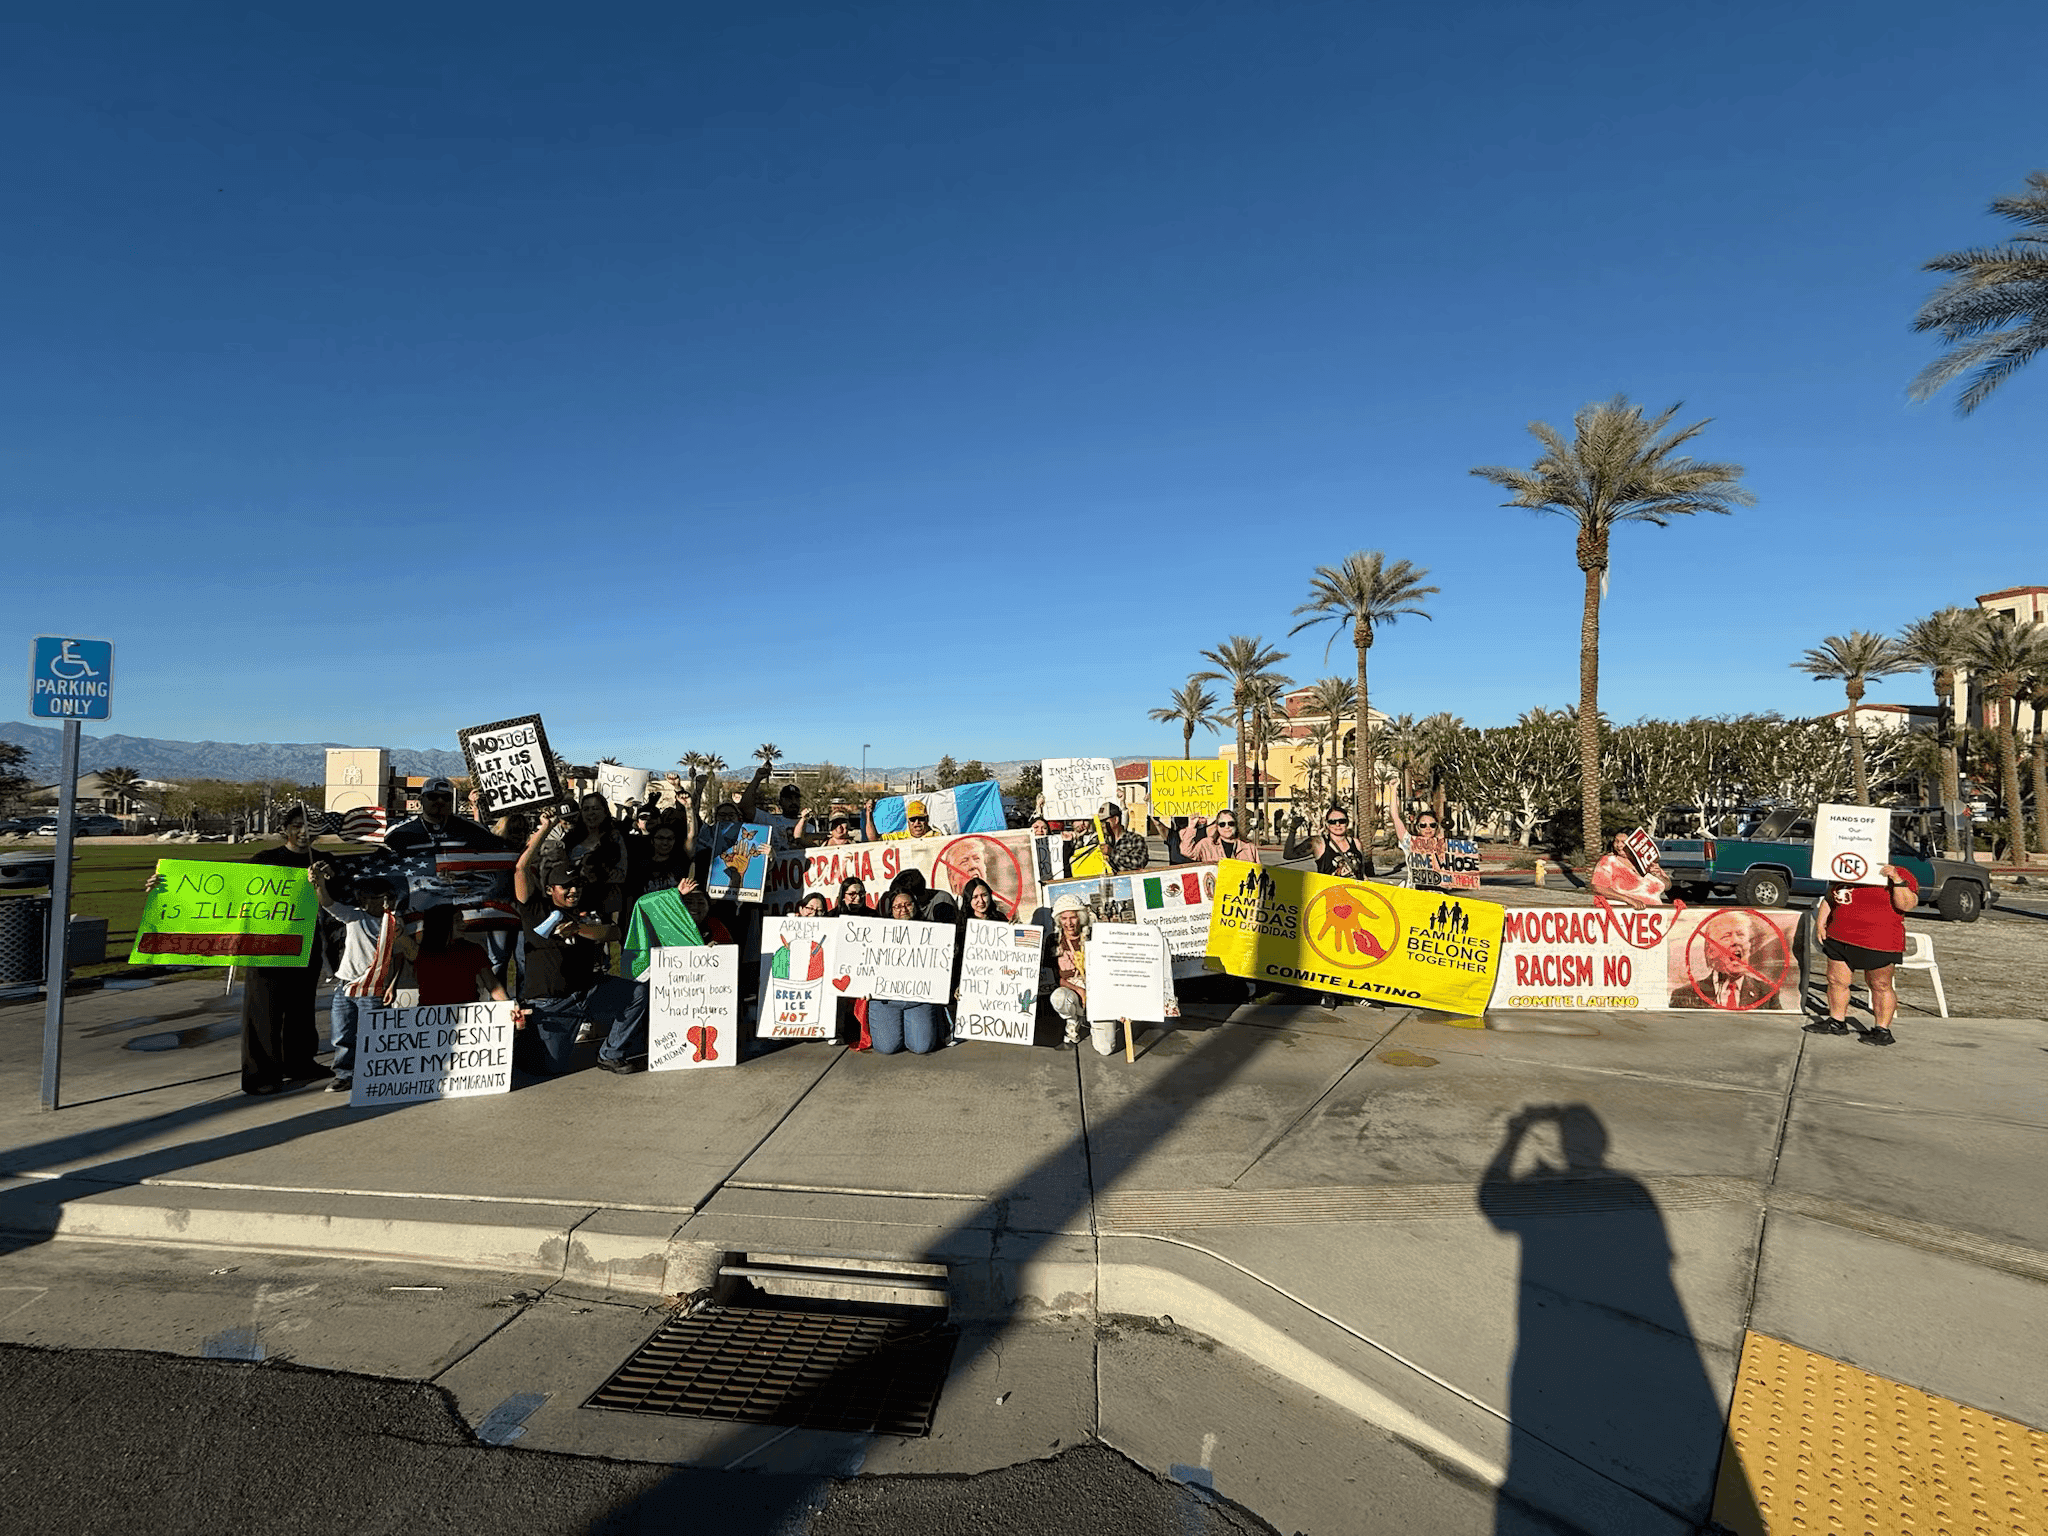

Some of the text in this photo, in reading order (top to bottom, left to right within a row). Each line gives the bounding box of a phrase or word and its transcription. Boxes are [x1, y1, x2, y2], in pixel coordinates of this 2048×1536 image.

[36, 678, 108, 697] PARKING
[50, 697, 92, 715] ONLY
[477, 749, 531, 774] LET US
[481, 768, 518, 789] WORK
[600, 762, 631, 787] FUCK
[1152, 765, 1224, 783] HONK IF
[485, 776, 552, 808] PEACE
[1057, 787, 1081, 800] ESTE
[1155, 784, 1214, 797] YOU HATE
[1829, 815, 1859, 823] HANDS
[881, 847, 901, 880] SI
[1434, 852, 1480, 873] WHOSE
[1839, 858, 1861, 875] ICE
[175, 873, 297, 897] NO ONE
[190, 901, 306, 922] ILLEGAL
[1222, 893, 1299, 915] FAMILIAS
[779, 920, 820, 932] ABOLISH
[1221, 903, 1297, 929] UNIDAS
[845, 921, 873, 944] SER
[919, 926, 936, 946] DE
[969, 922, 1009, 948] YOUR
[1220, 917, 1297, 940] NO DIVIDIDAS
[1409, 926, 1491, 949] FAMILIES
[1503, 911, 1663, 945] MOCRACY YES
[658, 950, 720, 969] This looks
[1406, 937, 1489, 963] BELONG
[839, 963, 876, 977] ES UNA
[1406, 950, 1487, 974] TOGETHER
[1514, 954, 1632, 988] RACISM NO
[874, 976, 932, 996] BENDICION
[962, 978, 1022, 996] THEY JUST
[1265, 964, 1422, 999] COMITE LATINO
[654, 984, 733, 1013] My history books
[775, 989, 813, 1001] BREAK
[784, 1001, 806, 1011] ICE
[1508, 995, 1639, 1009] COMITE LATINO
[366, 1003, 497, 1031] THE COUNTRY
[669, 1004, 729, 1019] had pictures
[778, 1011, 808, 1023] NOT
[771, 1025, 827, 1037] FAMILIES
[969, 1013, 1030, 1041] BROWN!
[363, 1035, 370, 1053] I
[374, 1030, 431, 1053] SERVE
[363, 1047, 508, 1078] SERVE MY PEOPLE
[365, 1072, 506, 1098] #DAUGHTER OF IMMIGRANTS
